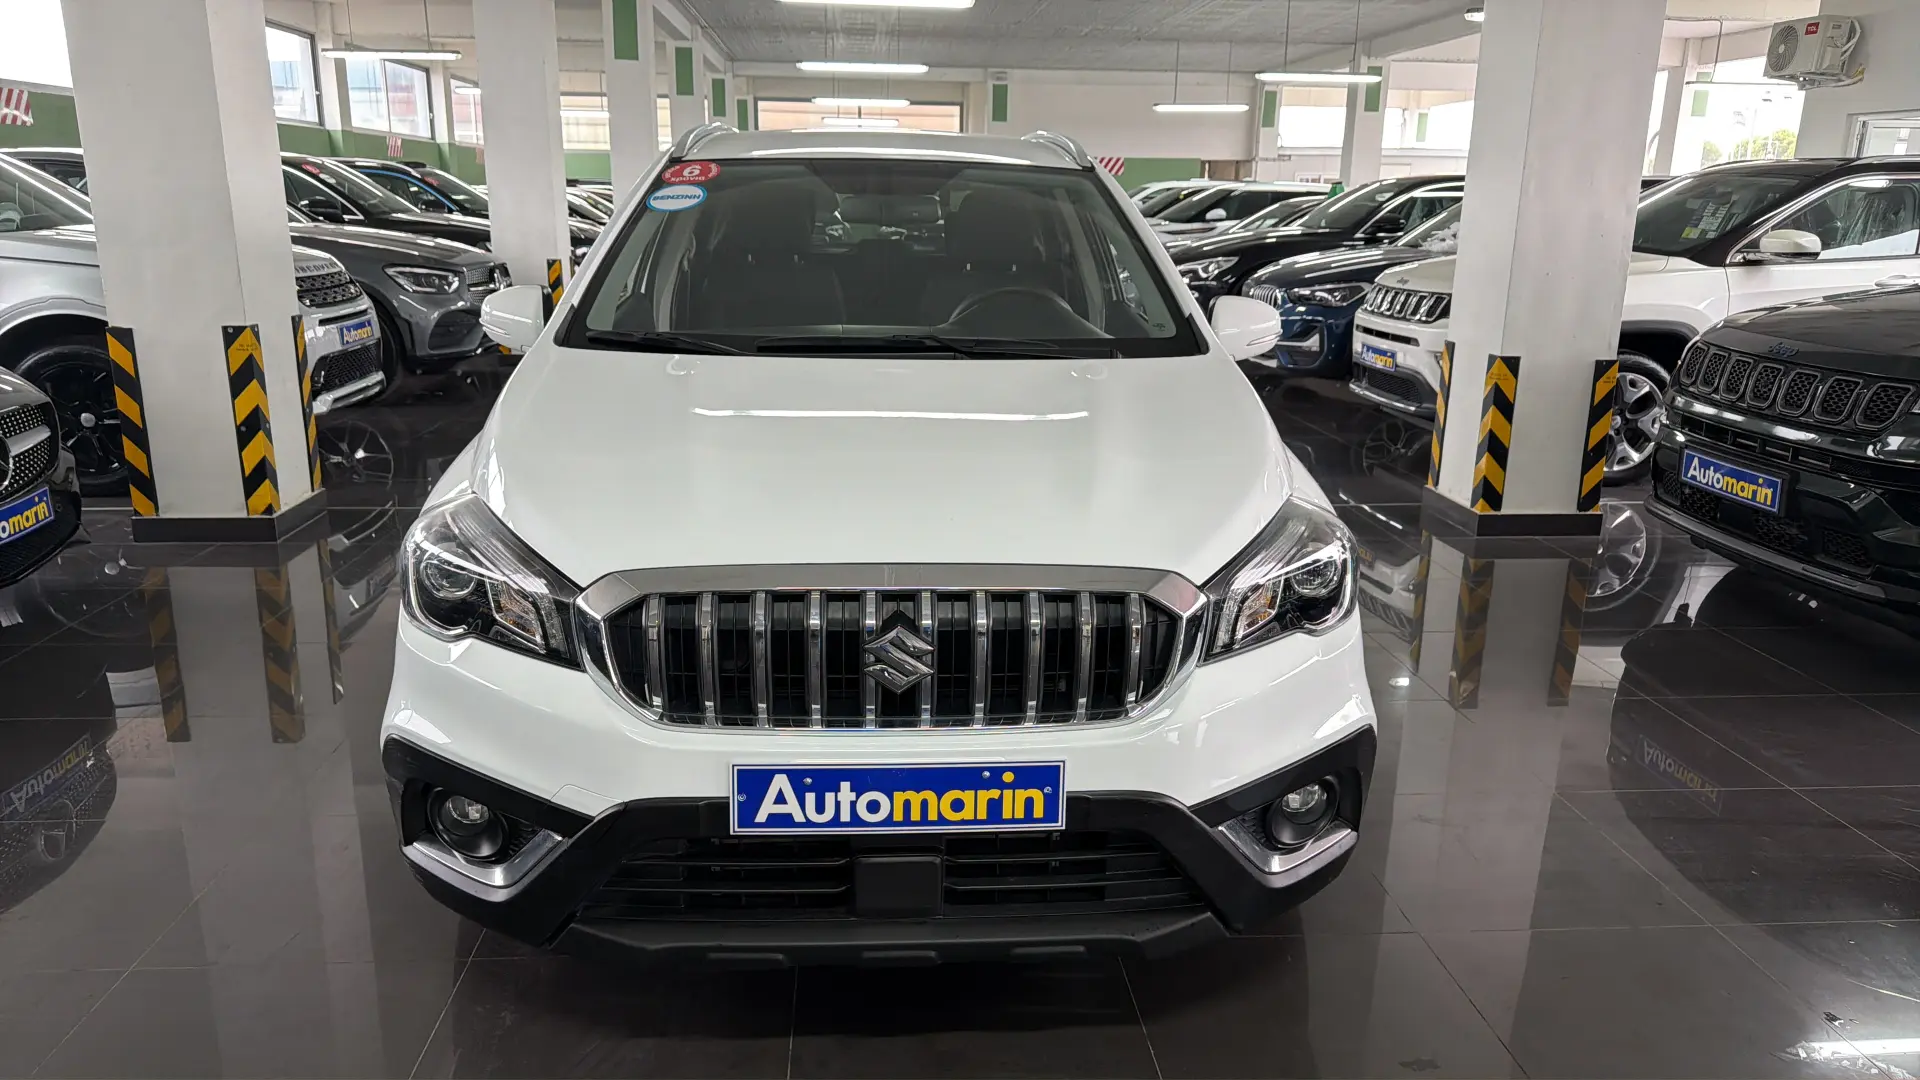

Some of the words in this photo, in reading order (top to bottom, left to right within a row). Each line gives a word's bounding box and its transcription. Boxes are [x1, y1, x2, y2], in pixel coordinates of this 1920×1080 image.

[683, 165, 702, 177] 6
[1361, 345, 1393, 368] Automarin
[1687, 456, 1774, 506] Automarin
[0, 496, 49, 539] omarin
[754, 771, 1044, 823] Automarin
